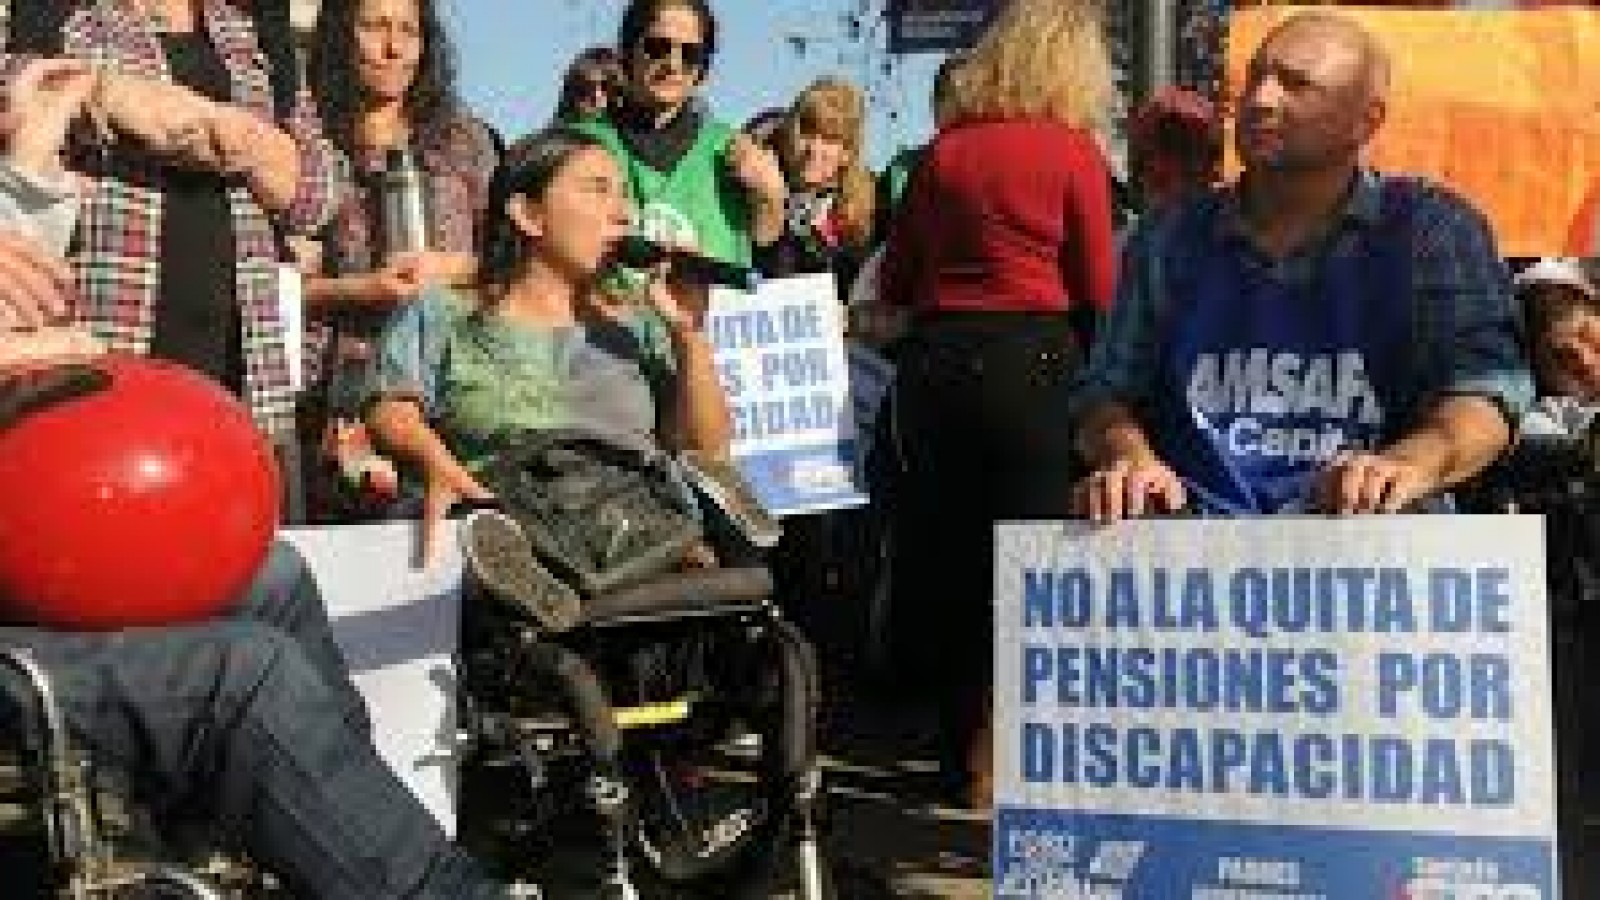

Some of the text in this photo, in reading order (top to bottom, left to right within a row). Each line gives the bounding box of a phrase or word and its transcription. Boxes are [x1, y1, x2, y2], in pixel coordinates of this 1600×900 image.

[1024, 568, 1510, 637] NO A LA QUITA DE
[1024, 648, 1514, 718] PENSIONES POR
[1024, 722, 1515, 804] DISCAPACIDAD
